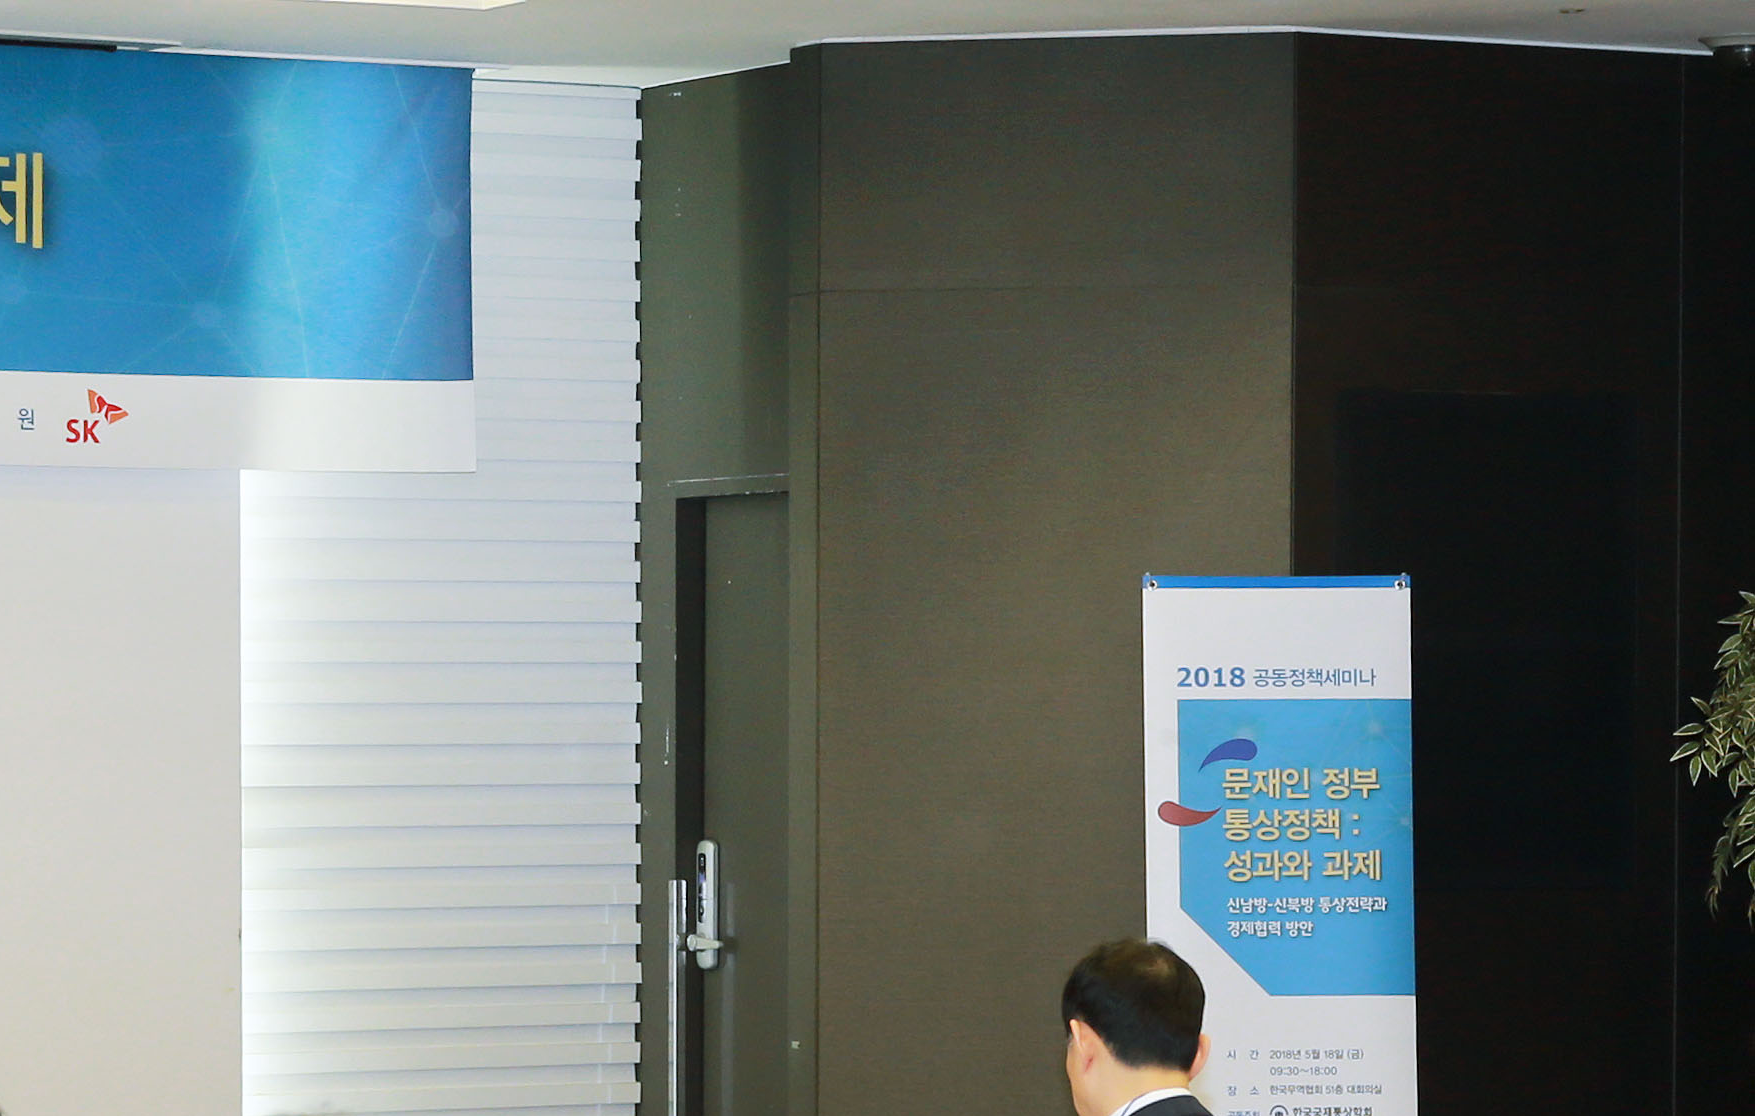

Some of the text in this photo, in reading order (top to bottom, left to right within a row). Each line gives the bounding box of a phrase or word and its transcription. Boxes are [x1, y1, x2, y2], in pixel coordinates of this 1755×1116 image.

[65, 418, 102, 444] SK
[1178, 667, 1376, 687] 2018 공동정책세미나
[1223, 768, 1380, 798] 문재인 정부
[1223, 808, 1359, 840] 통상정책 :
[1224, 850, 1380, 881] 성과와 과제
[1228, 897, 1387, 913] 신남방-신북방 통상전략과
[1228, 921, 1313, 937] 경제협력 방안
[1269, 1049, 1302, 1060] 2018년
[1305, 1049, 1321, 1060] 5월
[1324, 1049, 1344, 1060] 18일
[1269, 1084, 1323, 1096] 한국무역협회
